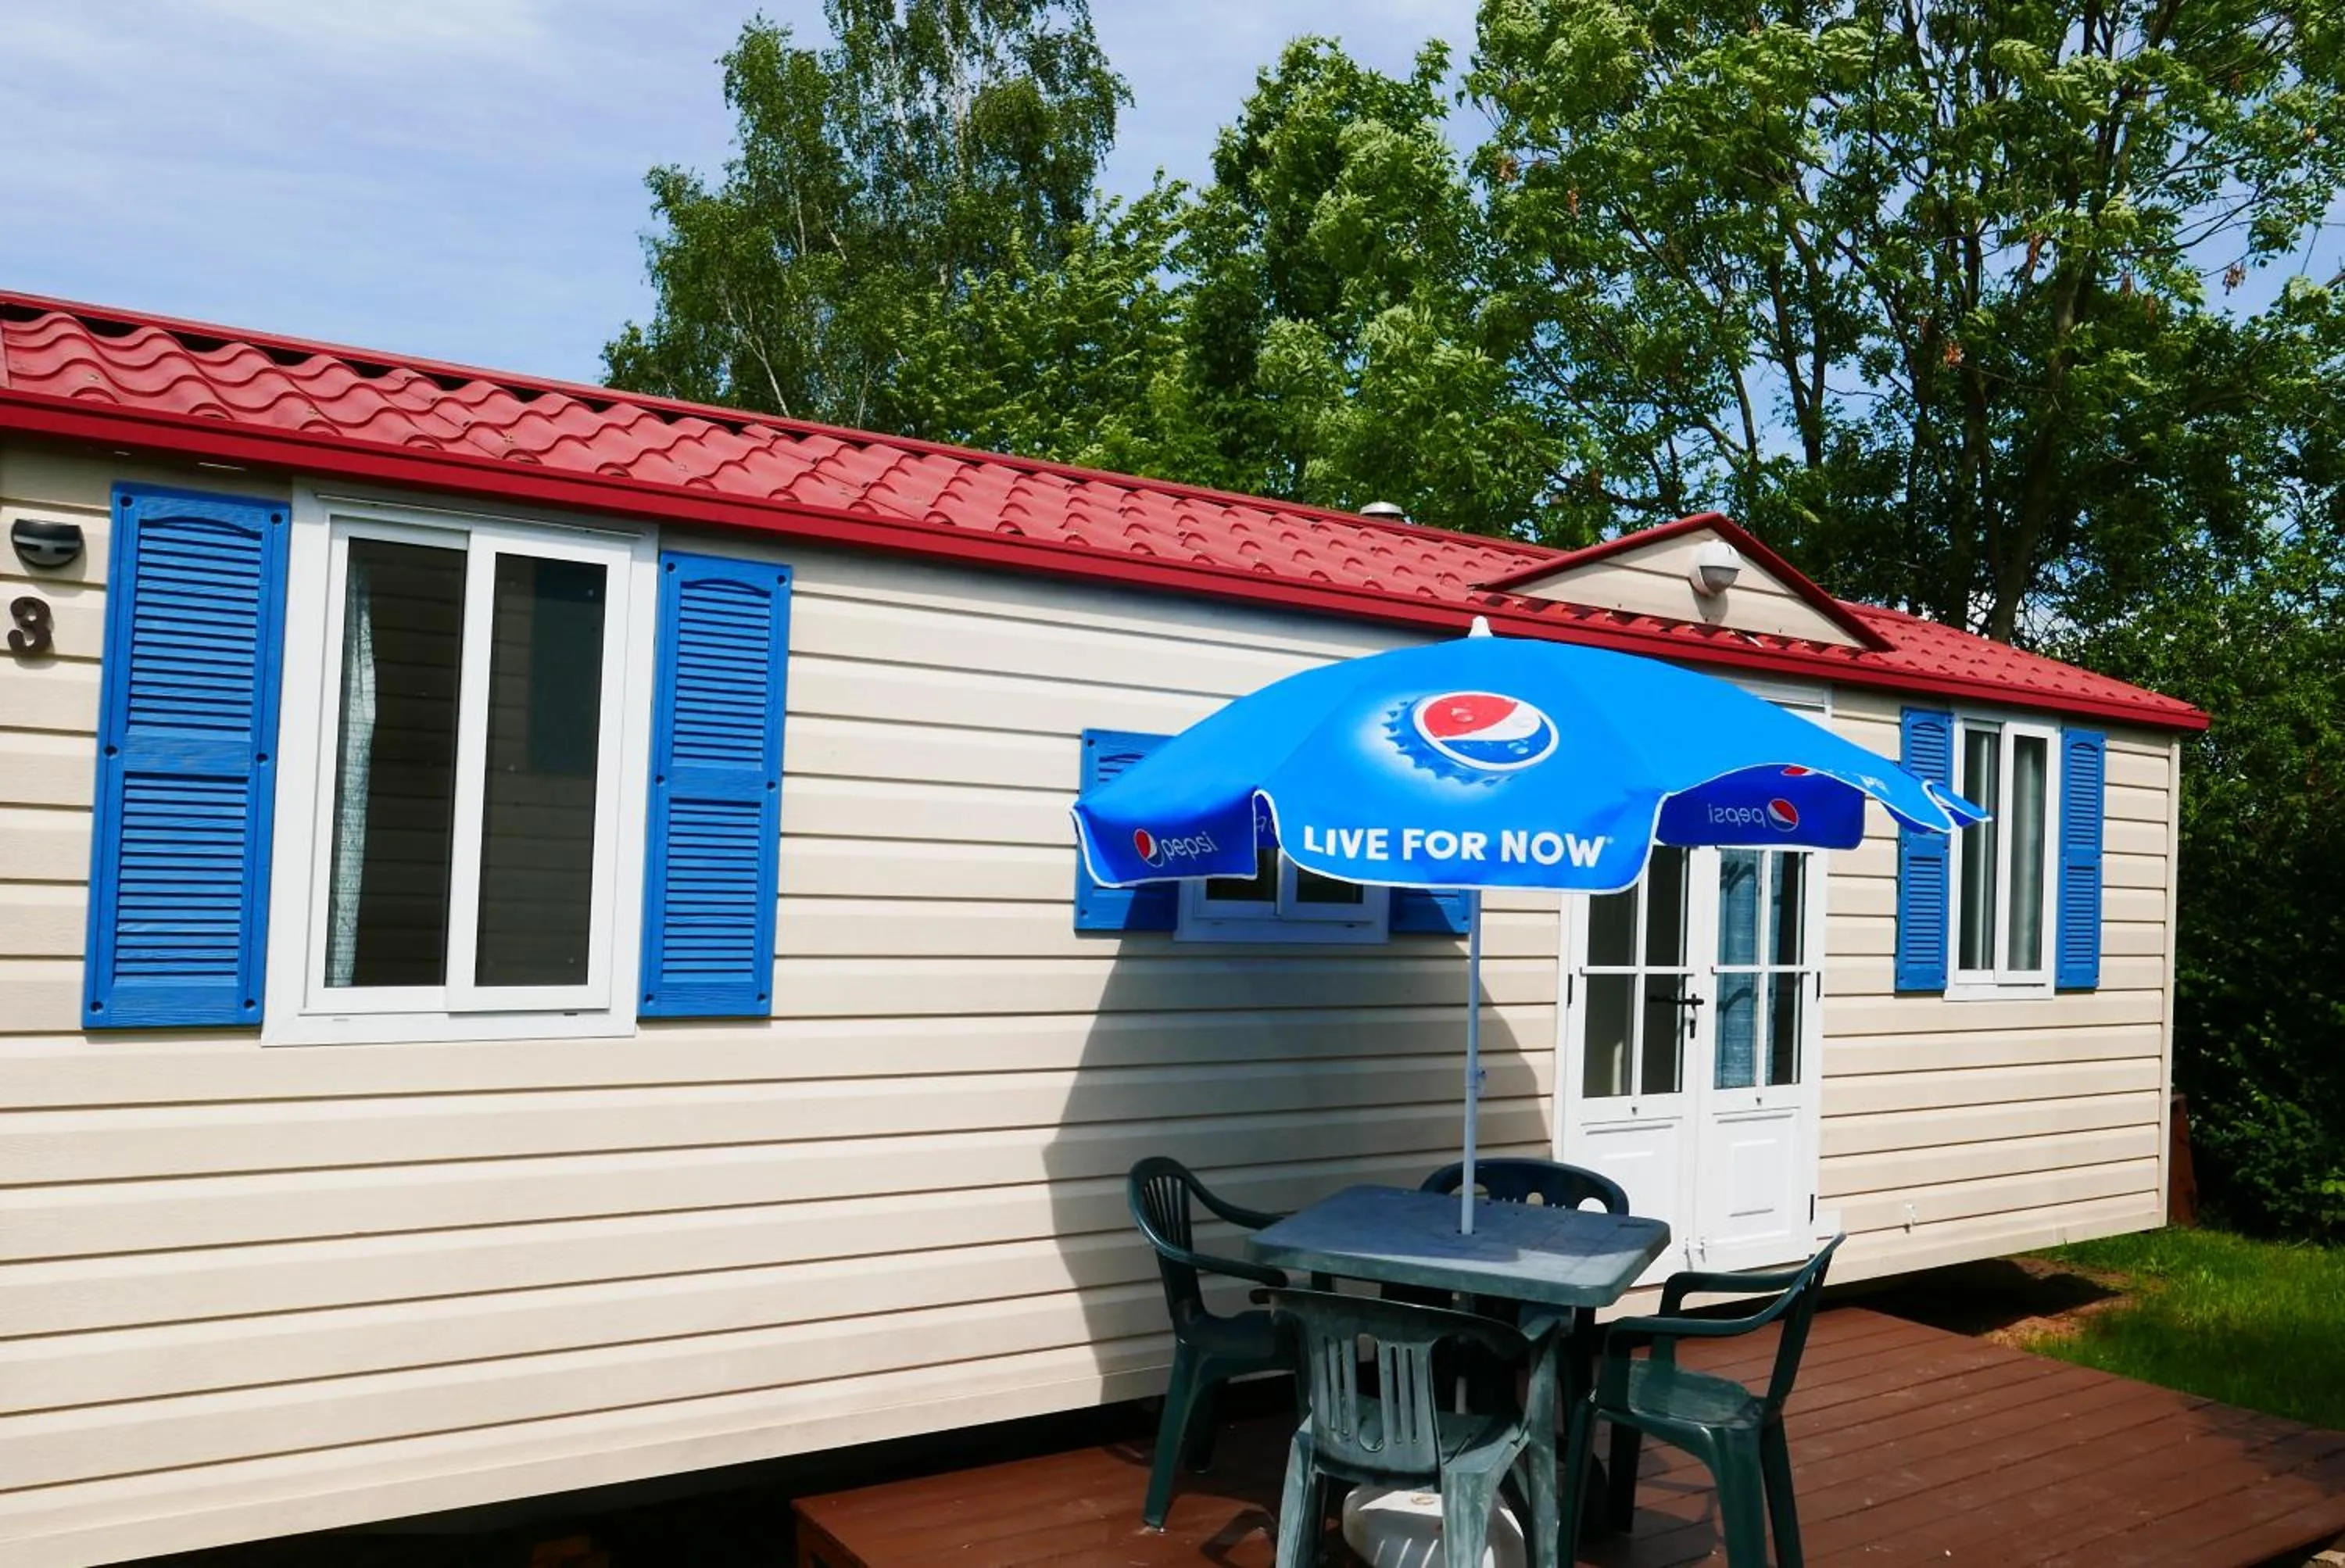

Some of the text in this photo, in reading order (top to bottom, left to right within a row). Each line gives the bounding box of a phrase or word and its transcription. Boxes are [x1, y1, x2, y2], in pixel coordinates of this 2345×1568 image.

[7, 596, 52, 653] 3
[1161, 830, 1219, 862] pepsi
[1304, 825, 1389, 861] LIVE
[1403, 829, 1488, 861] FOR
